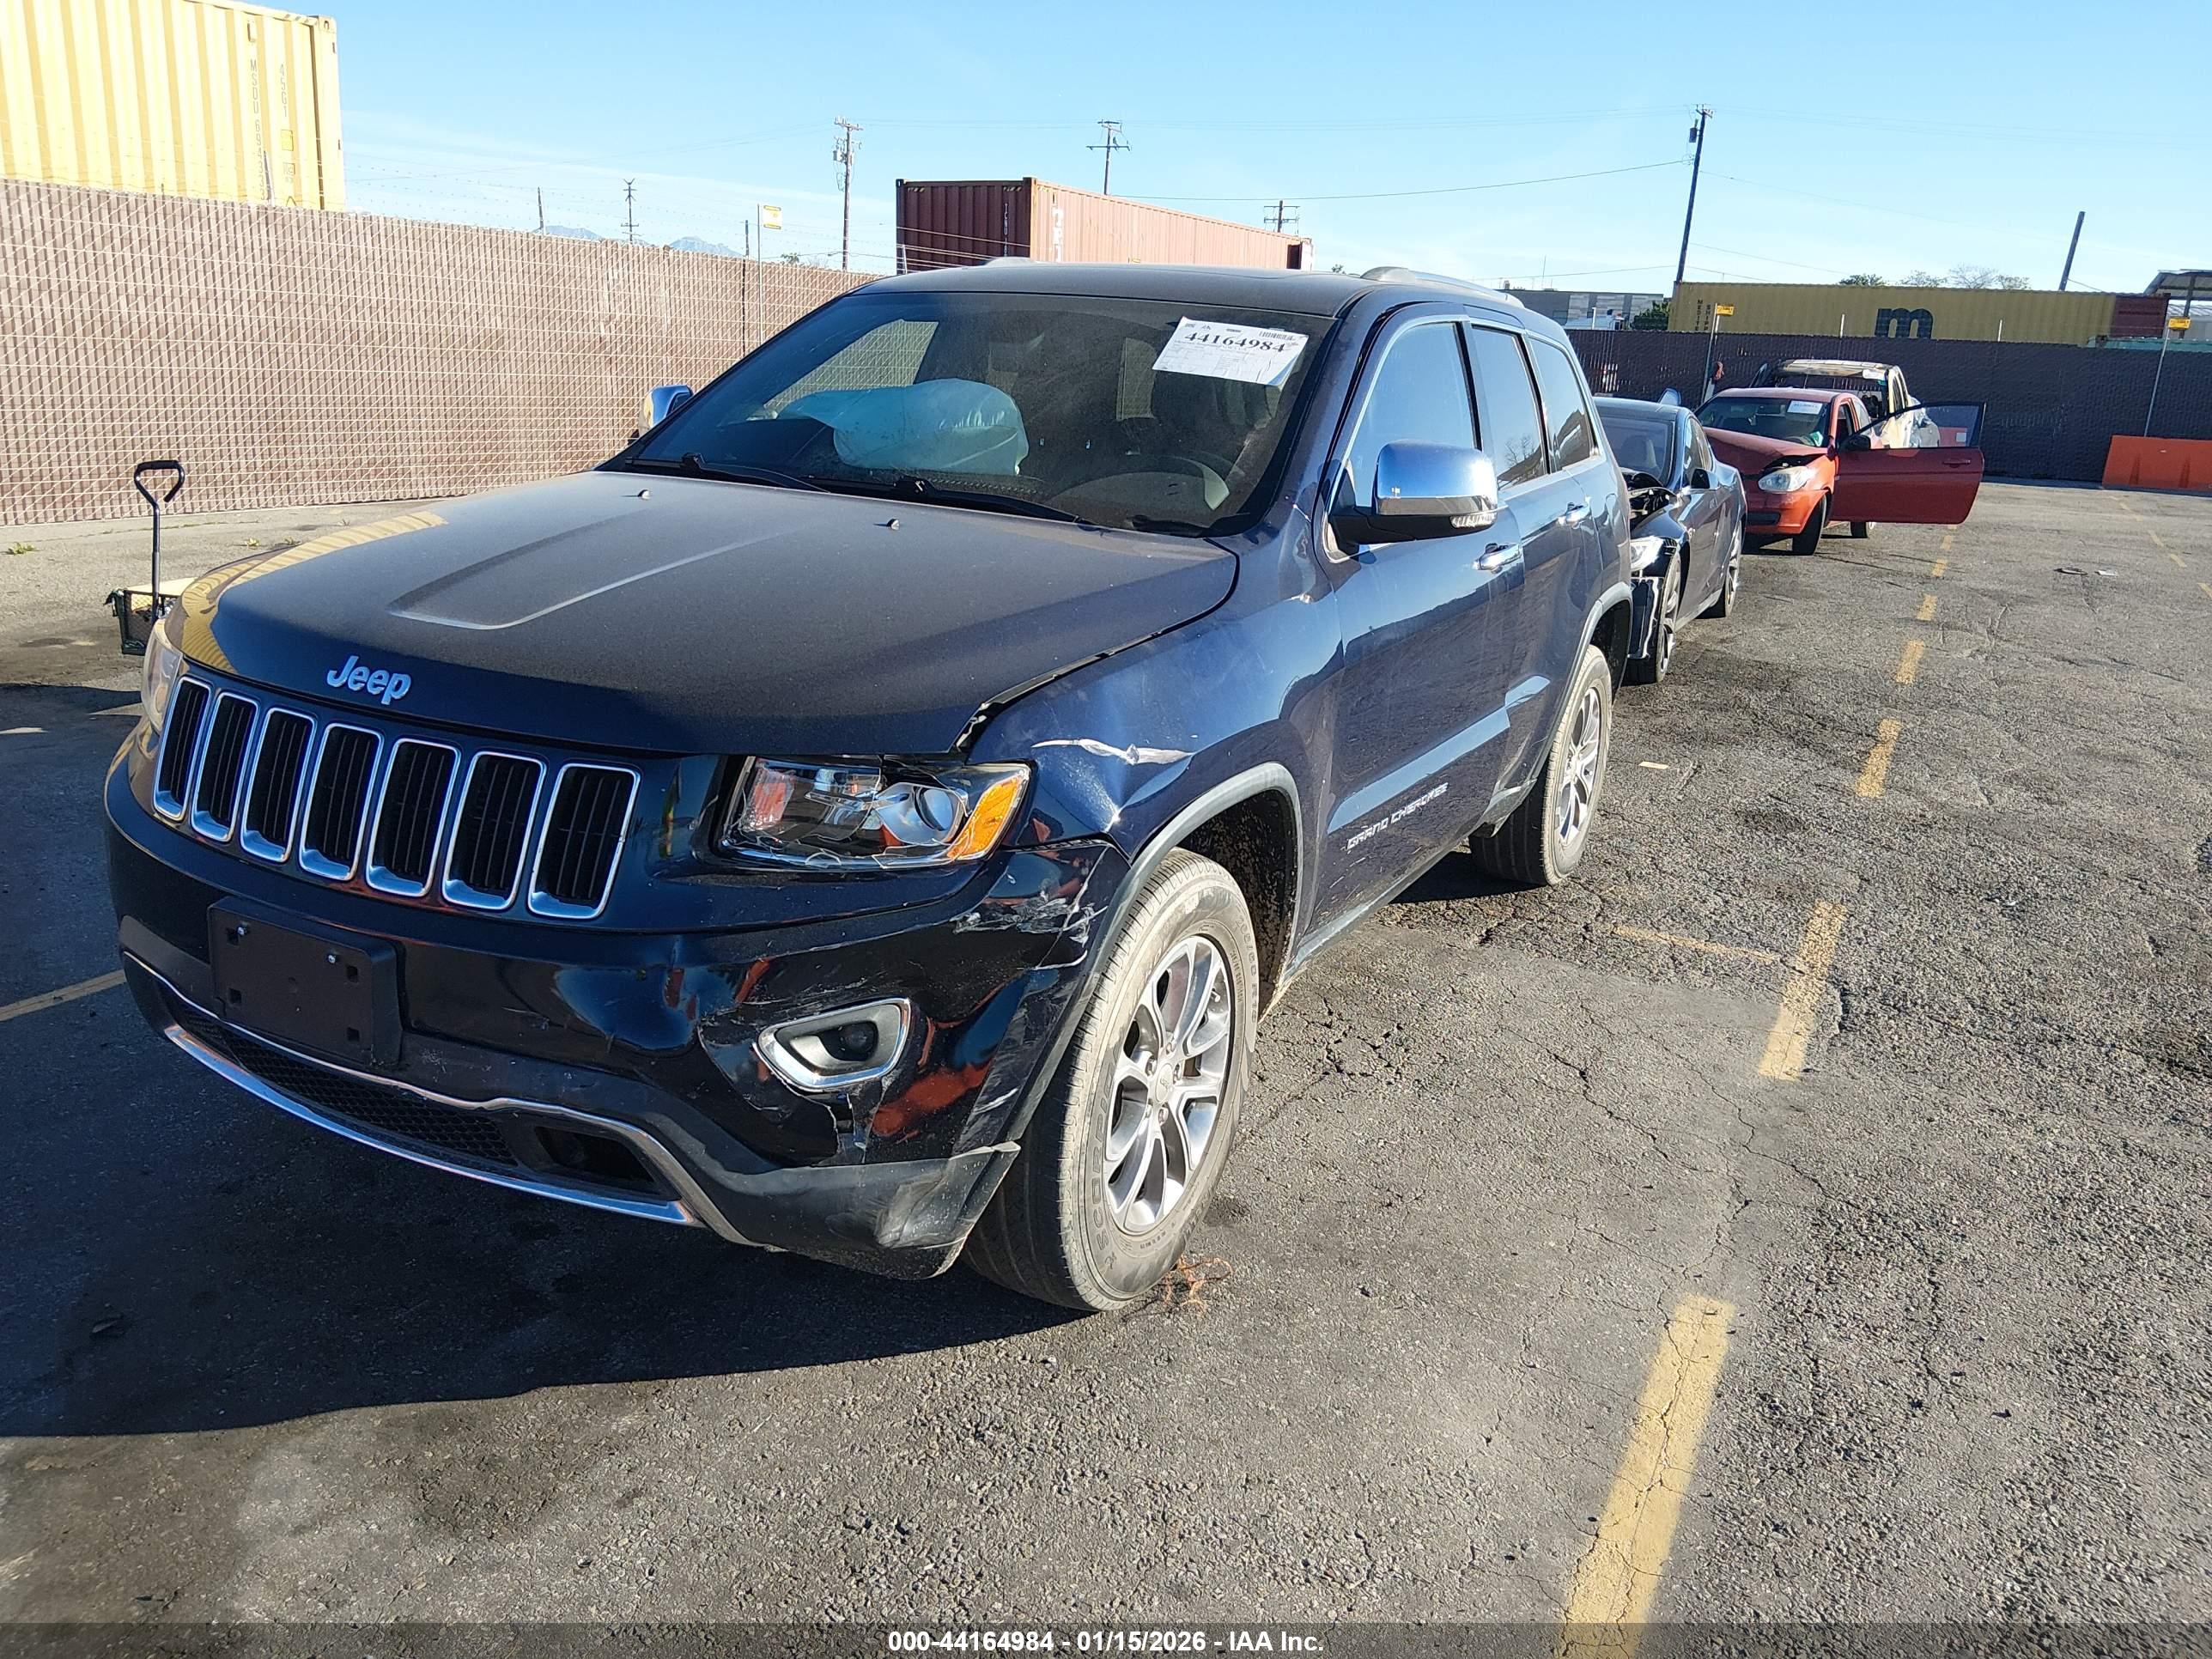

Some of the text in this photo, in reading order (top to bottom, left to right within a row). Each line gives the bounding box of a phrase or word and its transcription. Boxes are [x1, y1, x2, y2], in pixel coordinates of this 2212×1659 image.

[1184, 331, 1286, 353] 44164984
[327, 655, 411, 705] Jeep
[1346, 782, 1449, 851] GRAND CHEROKEE
